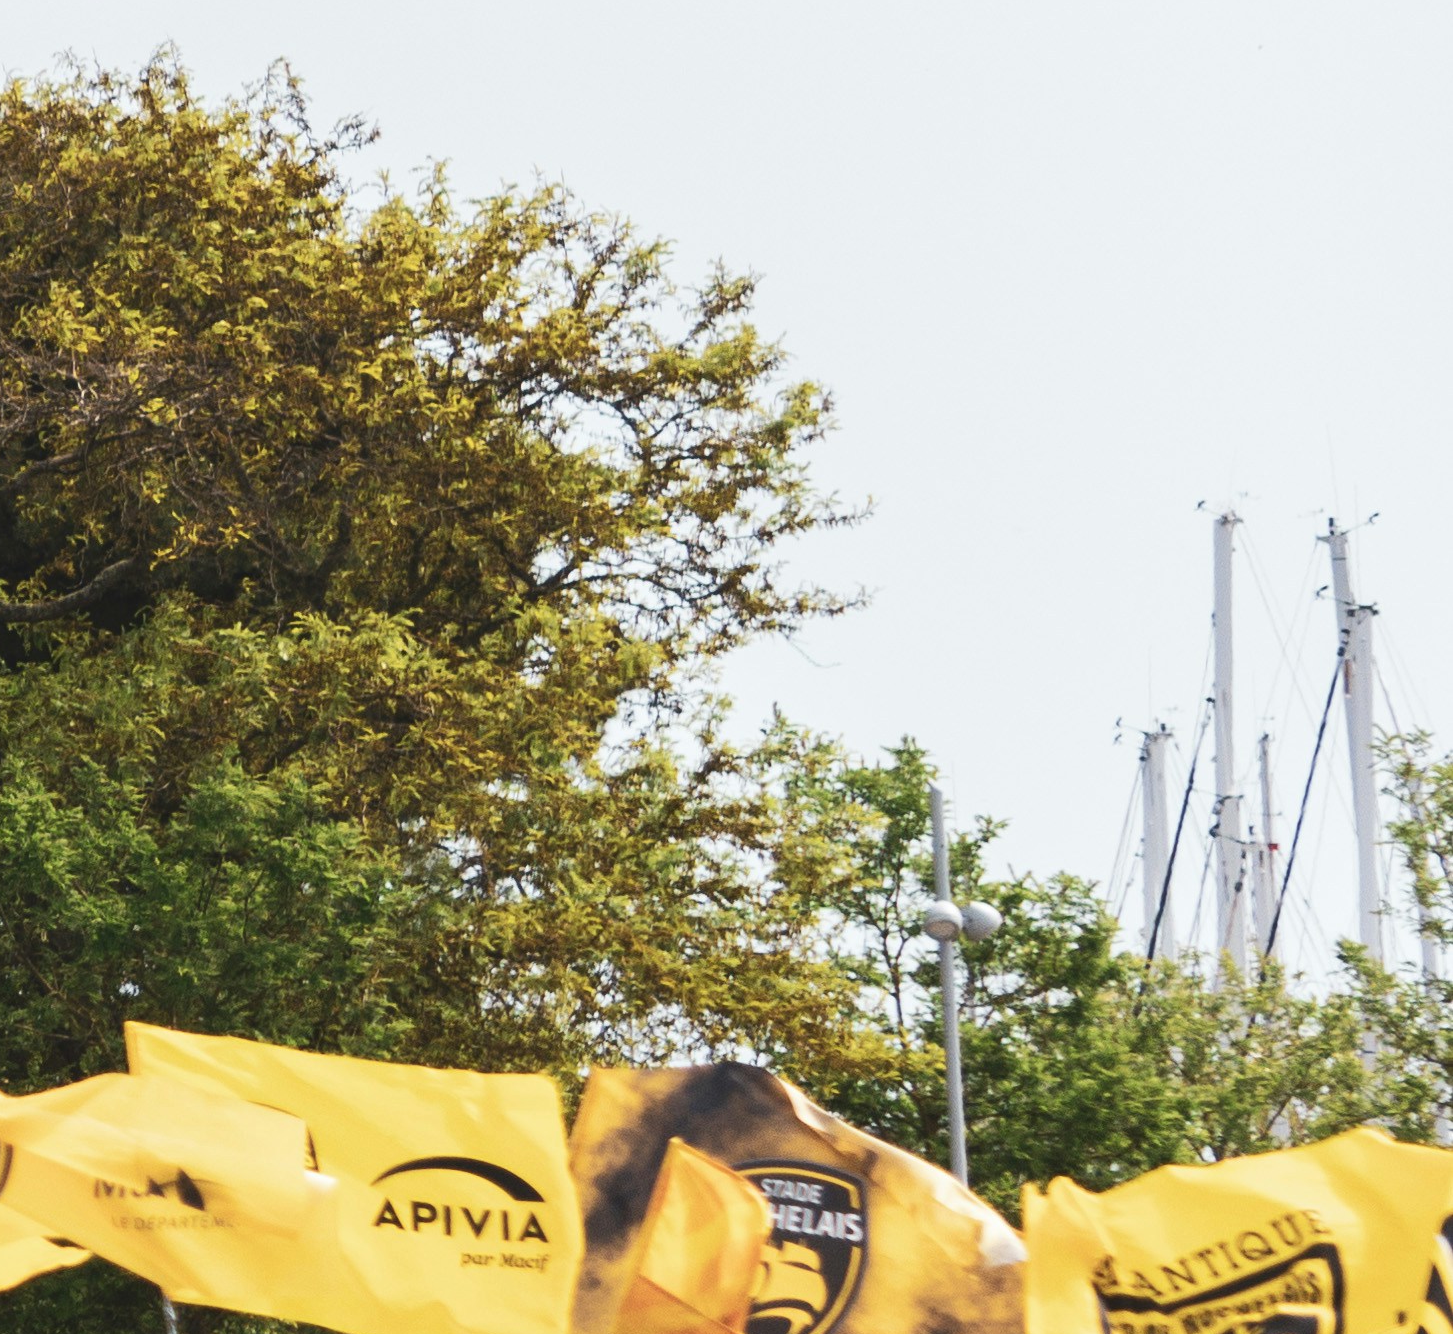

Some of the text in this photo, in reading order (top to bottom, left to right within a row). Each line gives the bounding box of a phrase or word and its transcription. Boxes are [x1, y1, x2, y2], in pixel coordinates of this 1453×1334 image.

[761, 1178, 824, 1205] STADE
[373, 1197, 549, 1243] APIVIA
[768, 1201, 864, 1242] HELAIS
[461, 1252, 549, 1273] par Macif
